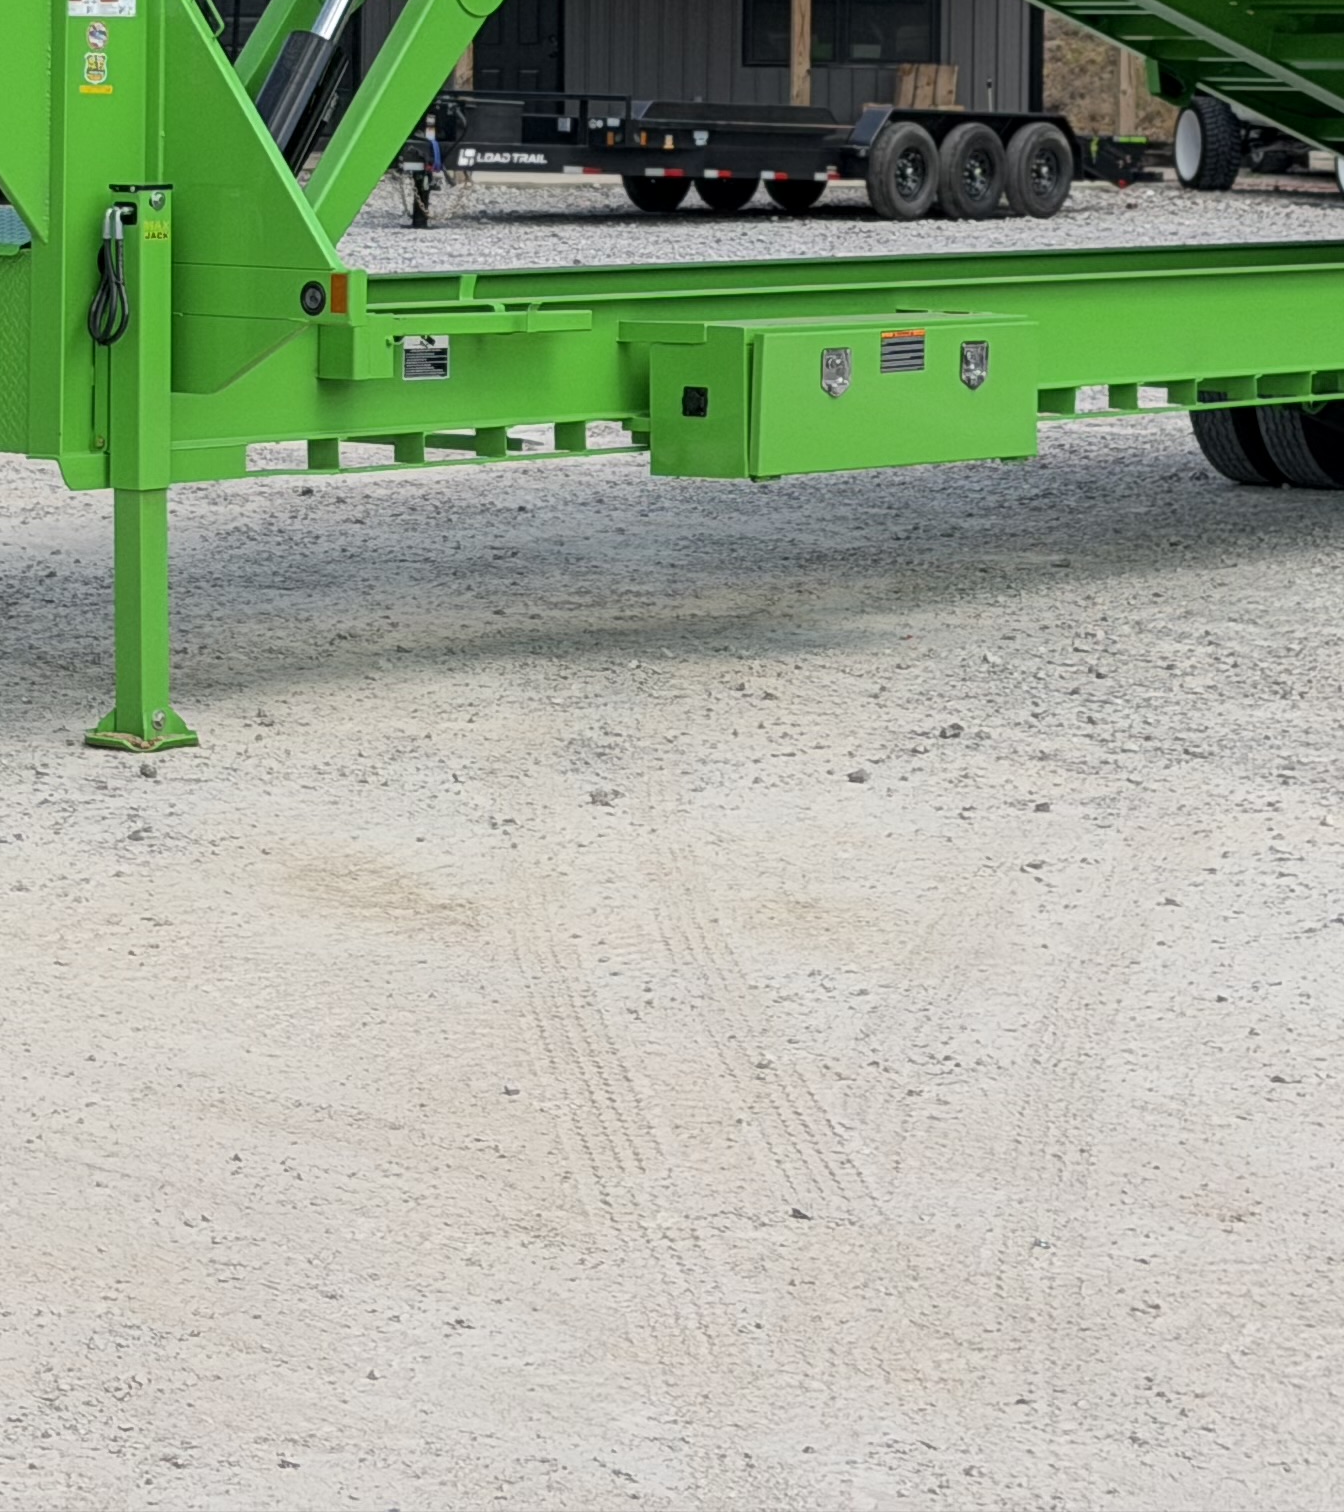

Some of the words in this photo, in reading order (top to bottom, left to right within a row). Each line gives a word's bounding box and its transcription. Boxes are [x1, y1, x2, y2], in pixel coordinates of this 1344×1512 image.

[476, 152, 510, 164] LOAD
[511, 152, 548, 165] TRAIL
[145, 231, 169, 240] JACK
